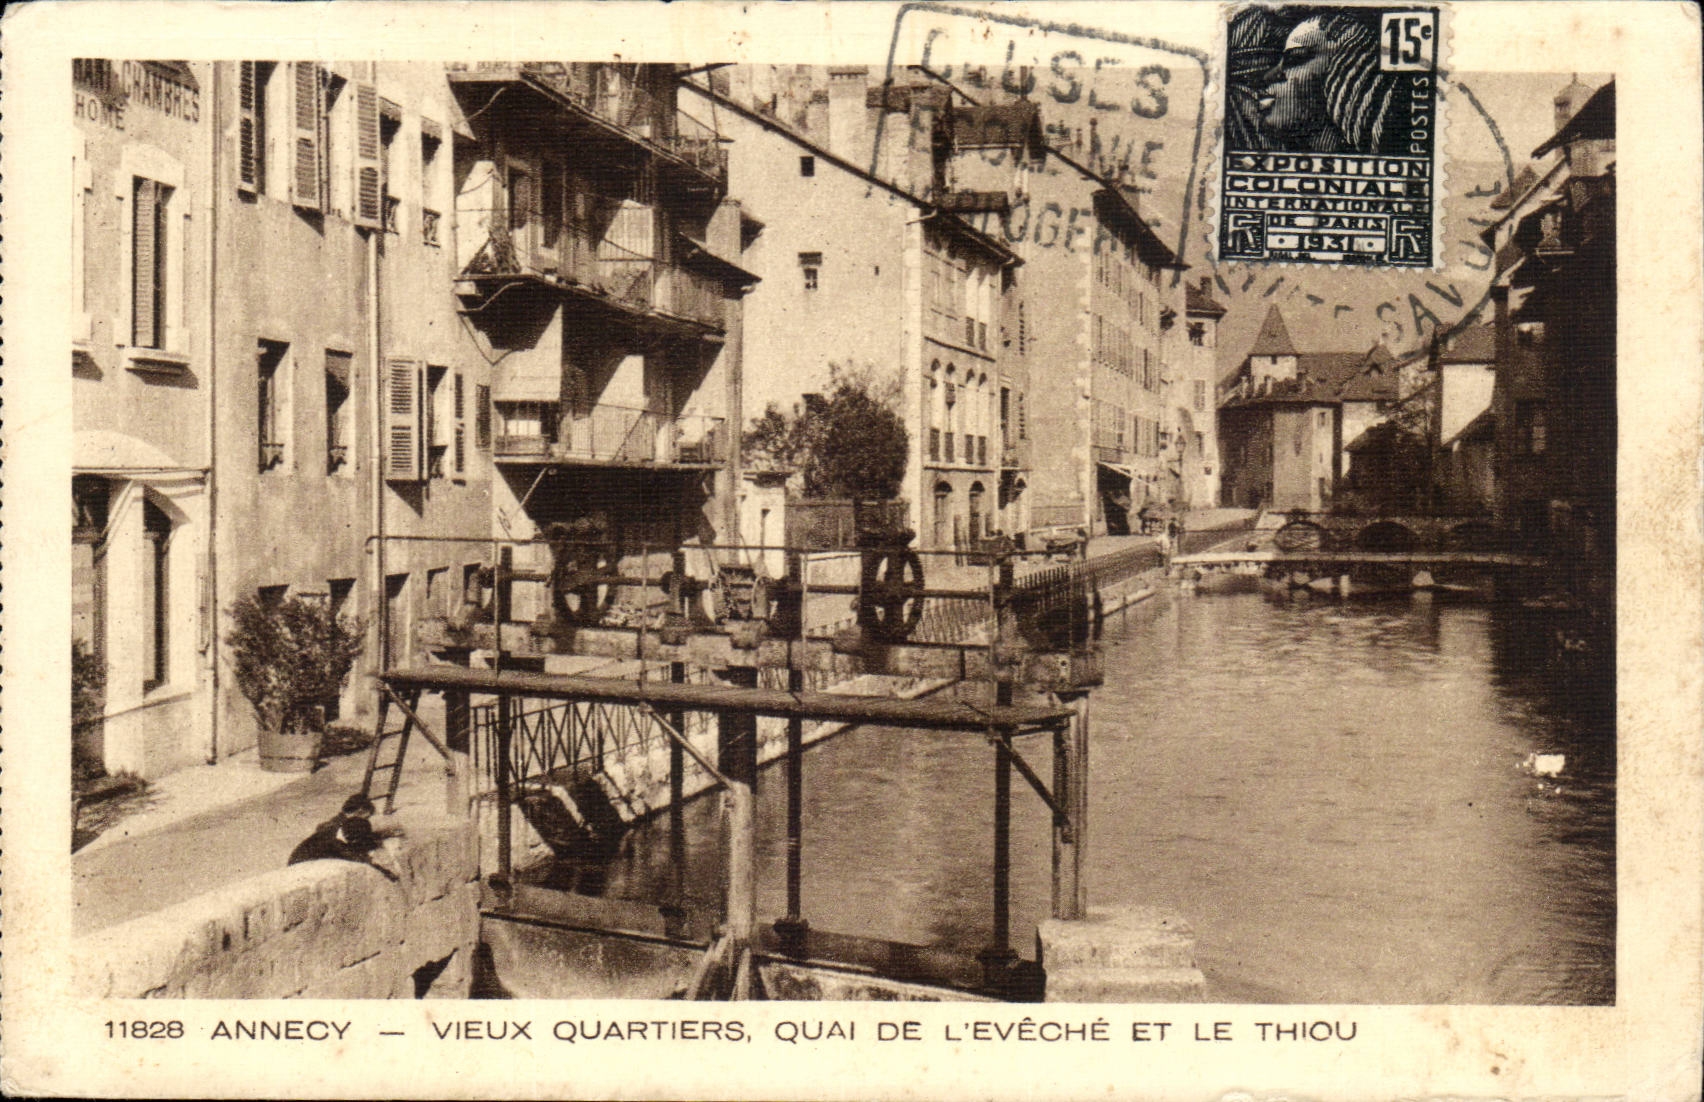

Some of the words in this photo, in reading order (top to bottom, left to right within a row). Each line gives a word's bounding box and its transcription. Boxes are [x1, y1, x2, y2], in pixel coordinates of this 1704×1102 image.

[1410, 76, 1430, 154] POSTES
[1228, 156, 1427, 177] EXPOSITION
[1228, 177, 1427, 198] COLONIALE
[1225, 197, 1428, 214] INTERNATIONALE
[1269, 214, 1296, 228] DE
[1318, 216, 1384, 230] PARIS
